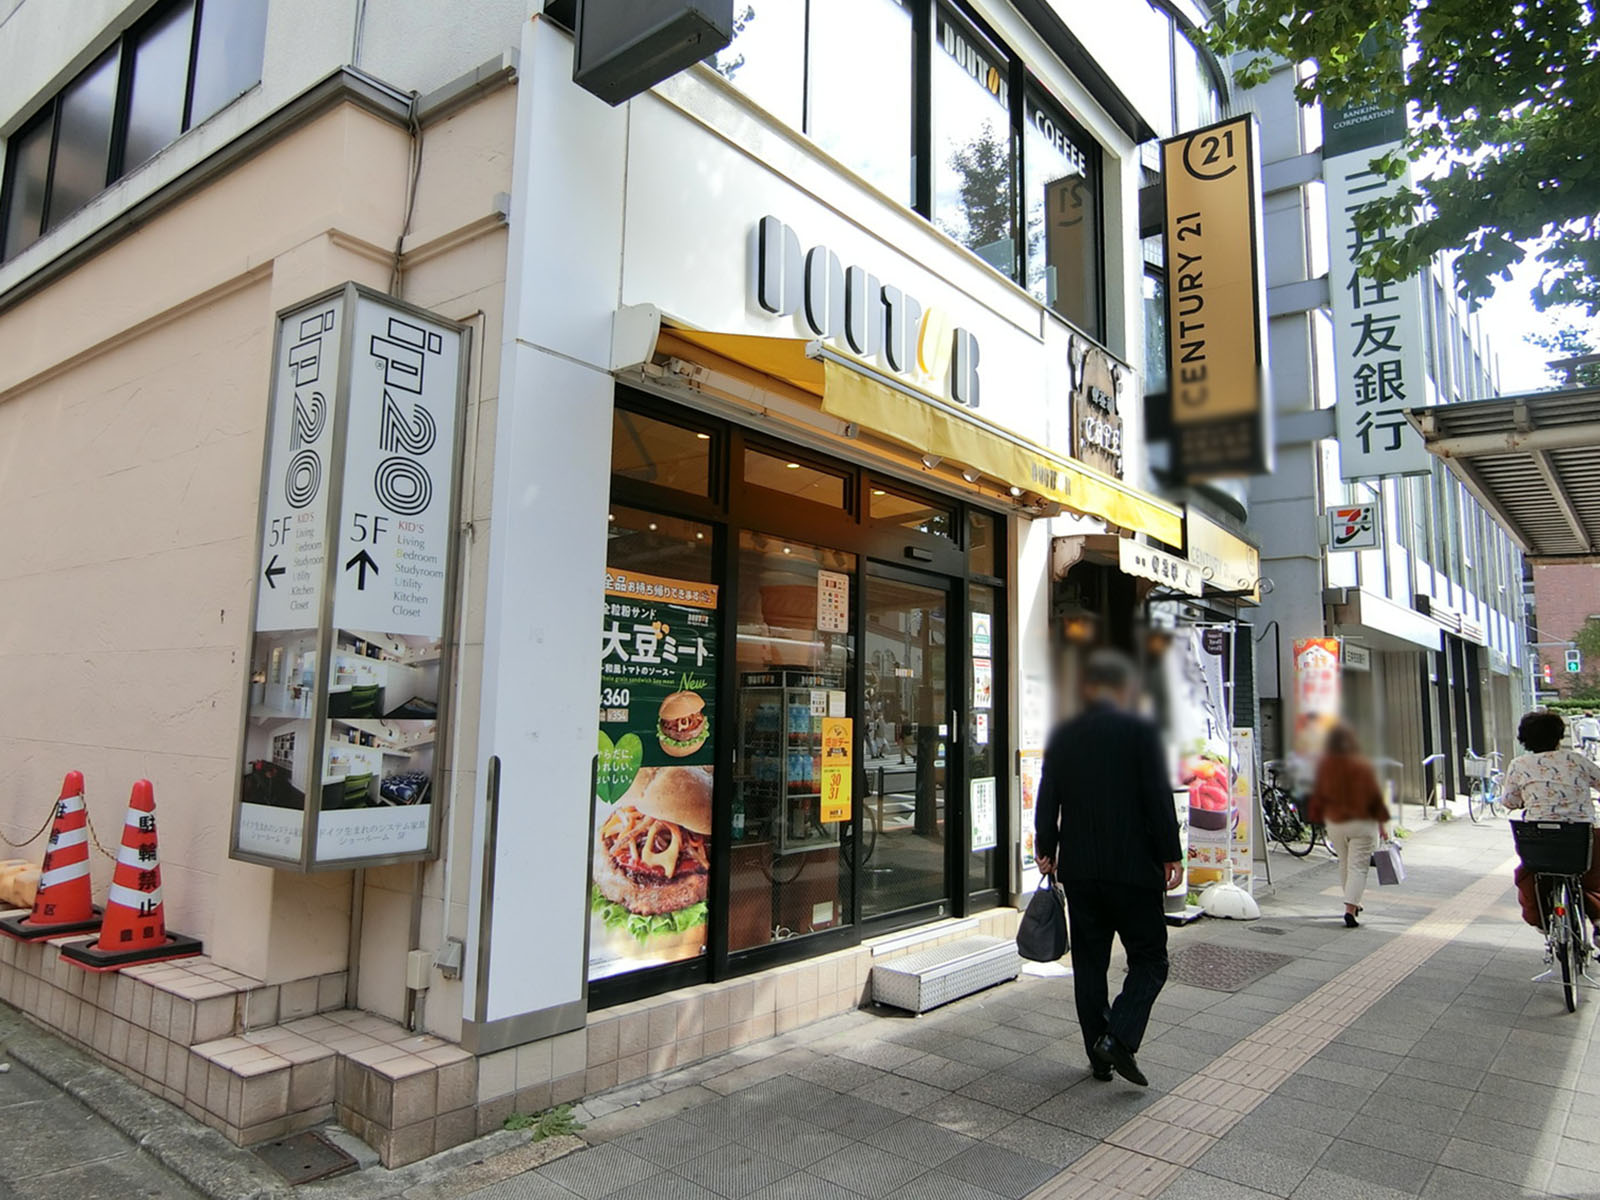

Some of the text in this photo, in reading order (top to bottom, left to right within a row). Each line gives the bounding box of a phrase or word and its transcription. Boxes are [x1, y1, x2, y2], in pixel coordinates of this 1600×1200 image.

[944, 22, 1009, 111] DOUTOR
[1333, 109, 1395, 130] CORPORATION
[1035, 110, 1086, 178] COFFEE
[758, 214, 980, 409] DOUTOR
[1176, 211, 1209, 409] CENTURY 21
[269, 516, 293, 548] 5F
[350, 513, 389, 545] 5F
[397, 520, 425, 533] KID'S
[397, 535, 425, 550] Living
[396, 548, 438, 564] Bedroom
[395, 563, 444, 579] Studyroom
[394, 578, 423, 592] Utility
[393, 592, 429, 605] Kitchen
[392, 605, 421, 618] Closet
[600, 621, 709, 667] 大豆ミート
[680, 672, 708, 694] New
[138, 814, 157, 918] 駐輪禁止
